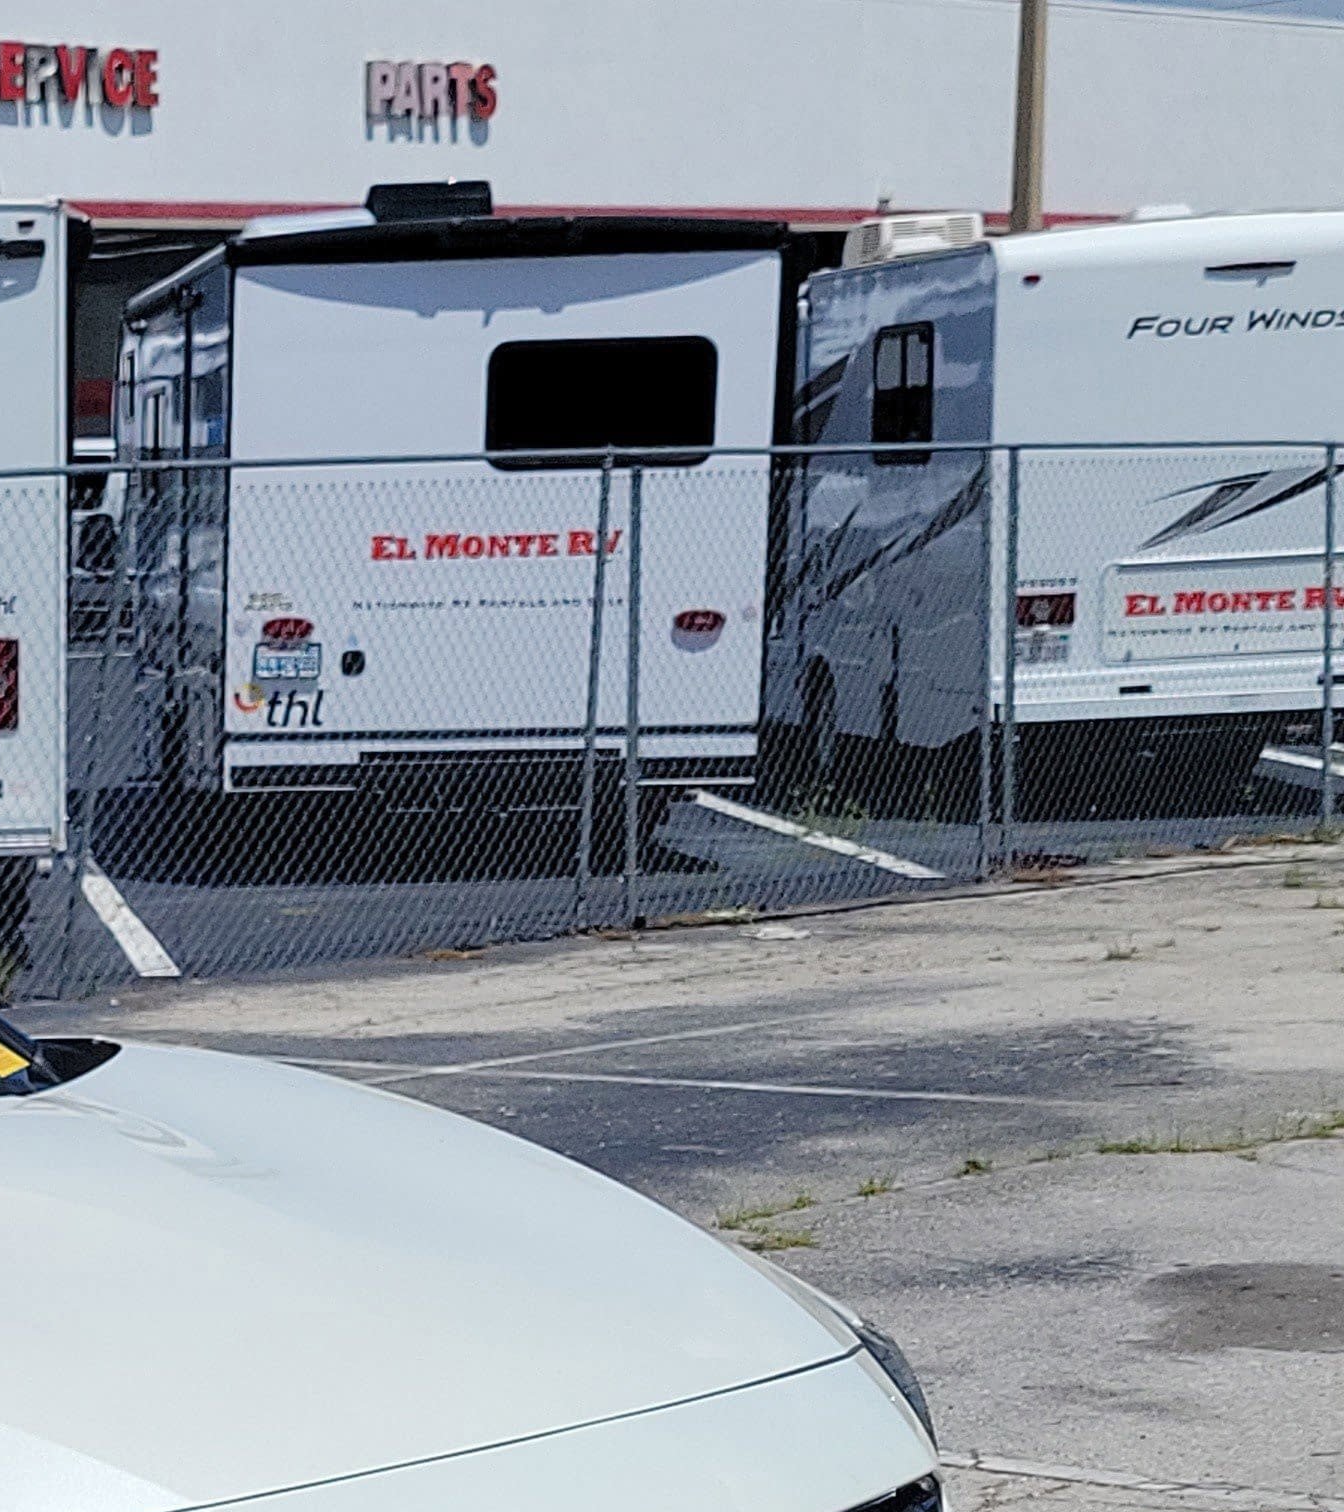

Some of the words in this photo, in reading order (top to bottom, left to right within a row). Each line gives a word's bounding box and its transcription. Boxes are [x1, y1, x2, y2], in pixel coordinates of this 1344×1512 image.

[366, 61, 496, 119] PARTS
[1127, 314, 1235, 340] FOUR
[371, 535, 416, 560] EL
[424, 533, 559, 560] MONTE
[1125, 594, 1166, 617] EL
[1173, 590, 1296, 613] MONTE
[267, 689, 324, 727] thl
